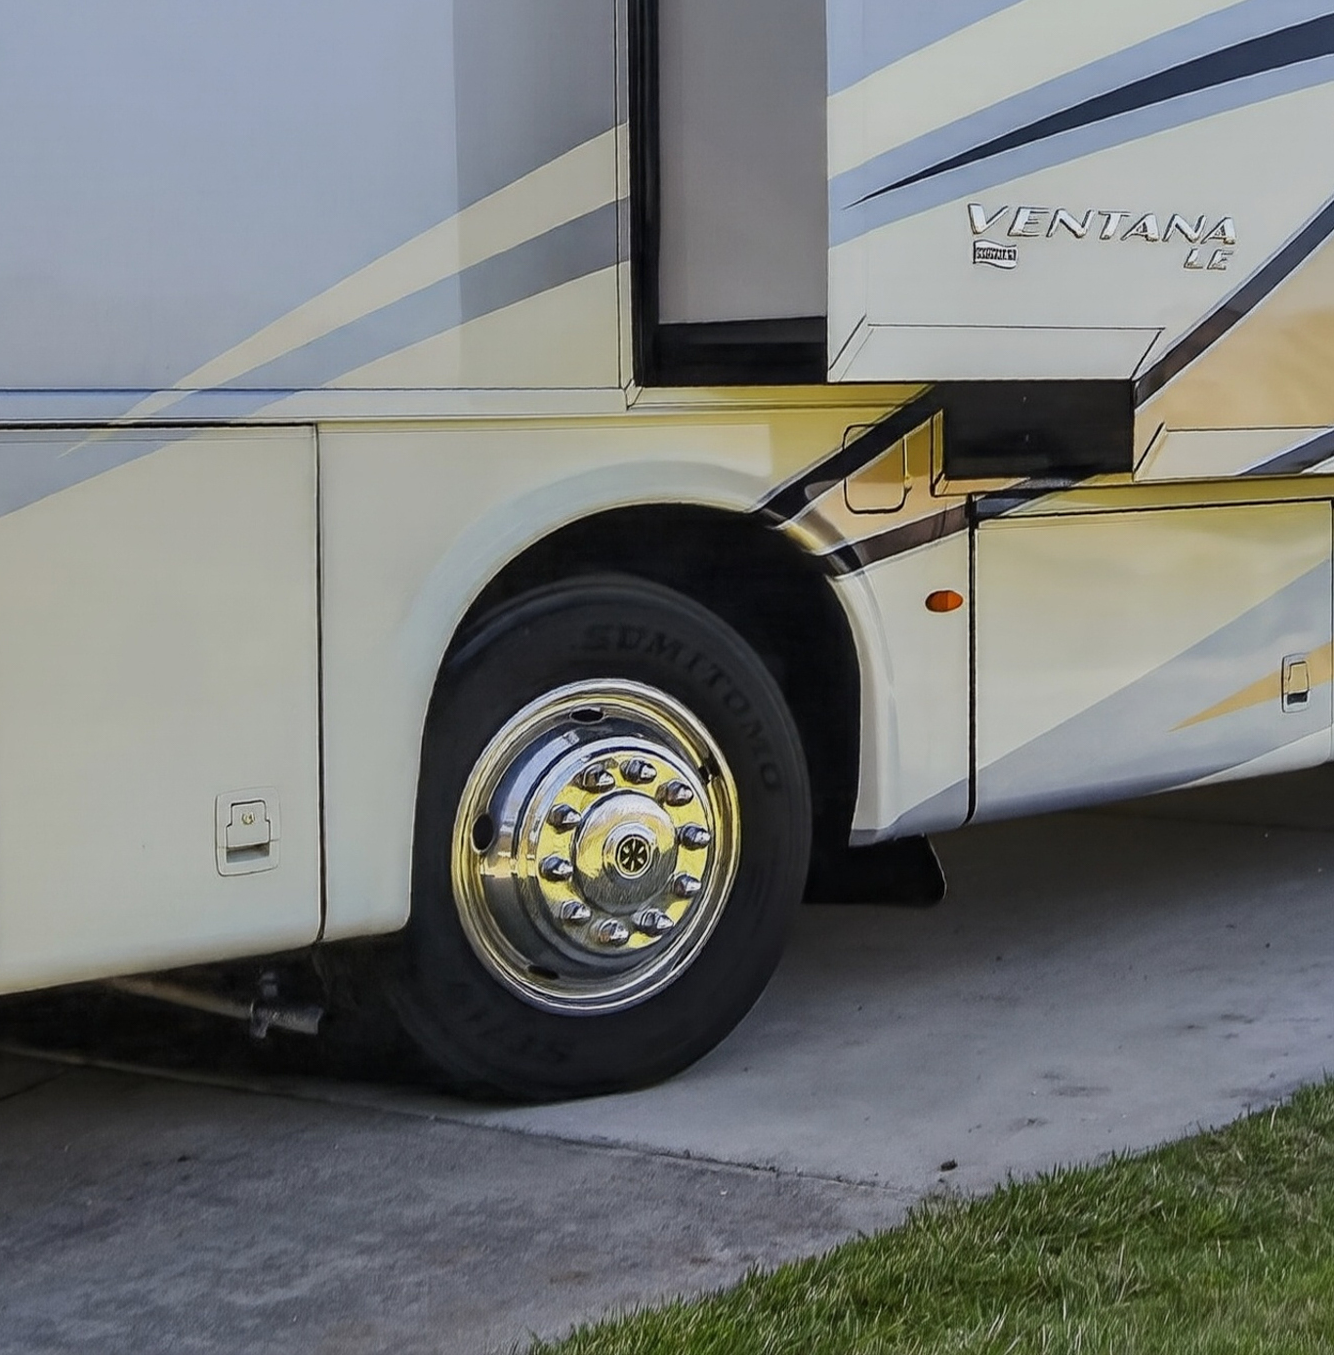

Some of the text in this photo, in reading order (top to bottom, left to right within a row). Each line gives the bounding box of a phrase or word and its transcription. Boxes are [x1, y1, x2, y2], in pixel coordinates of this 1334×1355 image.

[967, 203, 1236, 245] VENTANA
[1183, 248, 1234, 271] LE
[575, 623, 782, 791] SUMITOMO
